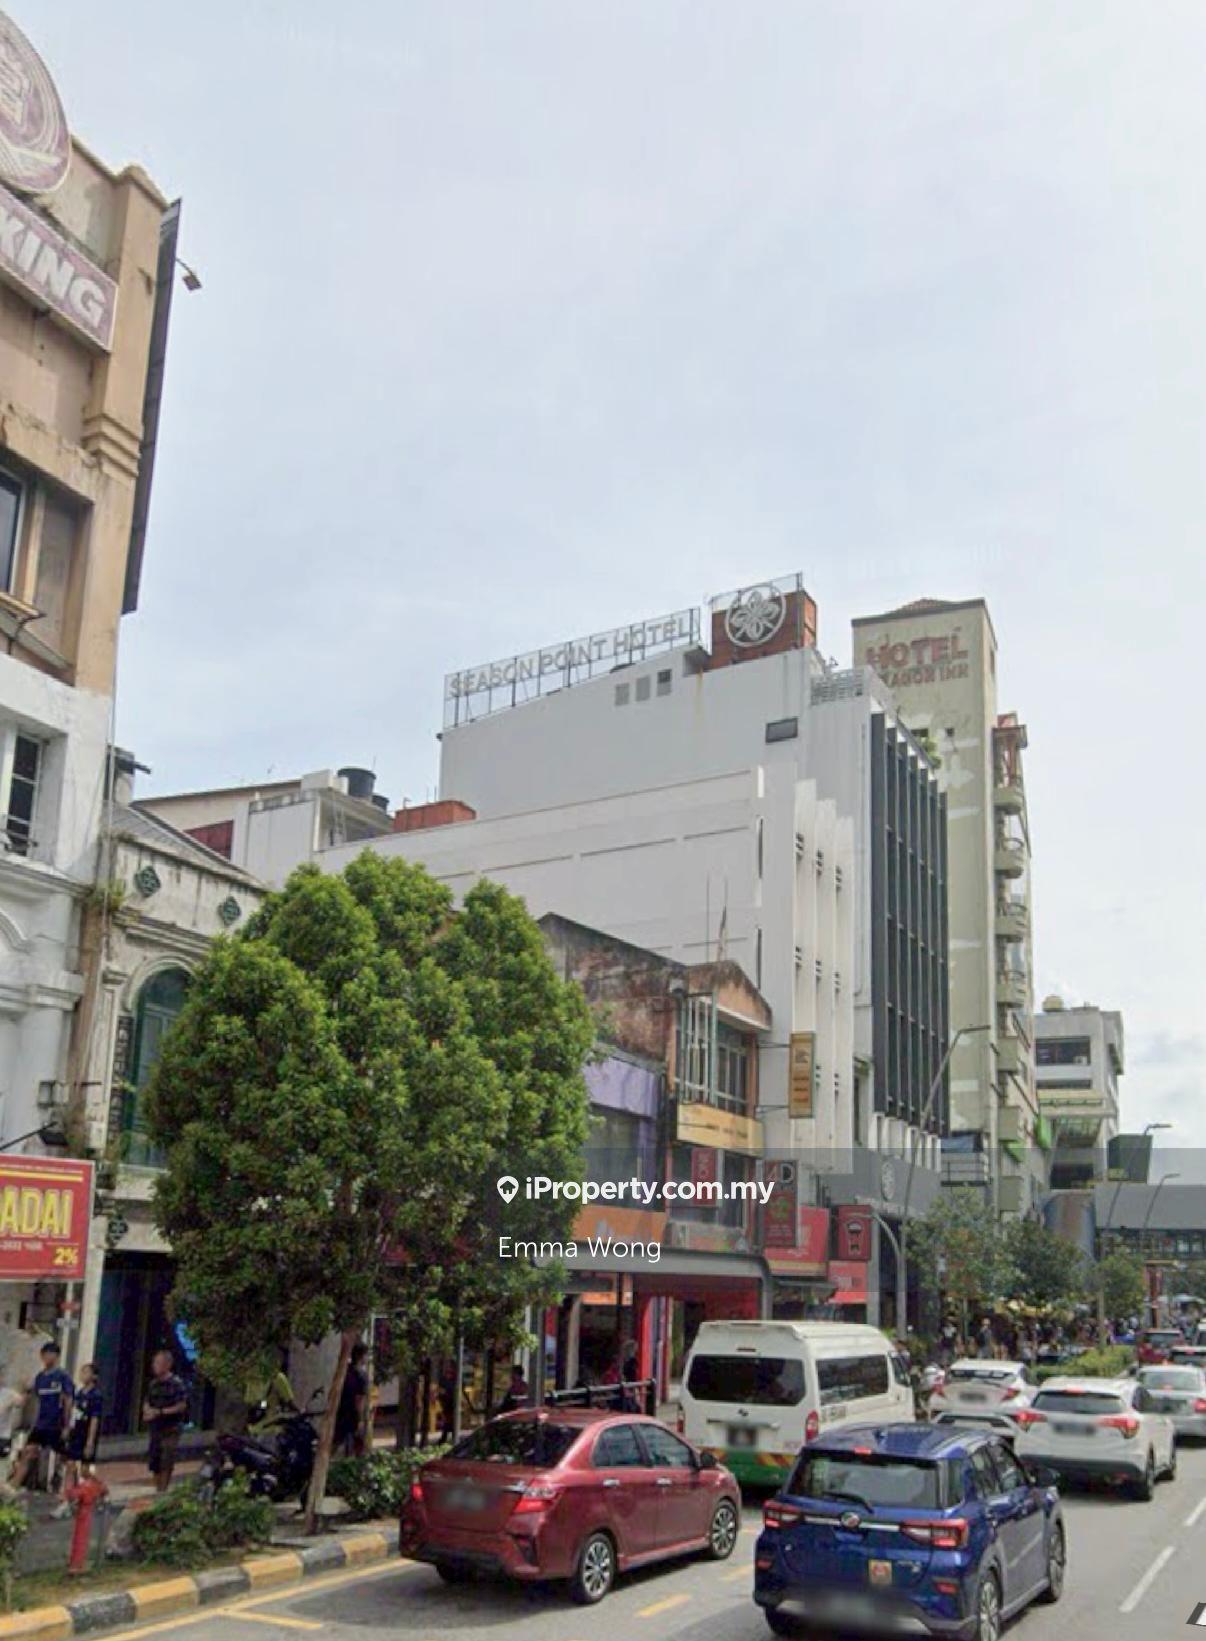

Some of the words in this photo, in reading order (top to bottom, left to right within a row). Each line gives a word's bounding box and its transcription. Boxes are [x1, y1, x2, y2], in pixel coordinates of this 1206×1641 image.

[450, 660, 535, 698] SEASON
[539, 637, 608, 673] POINT
[612, 615, 692, 657] HOTEL
[866, 632, 969, 670] HOTEL
